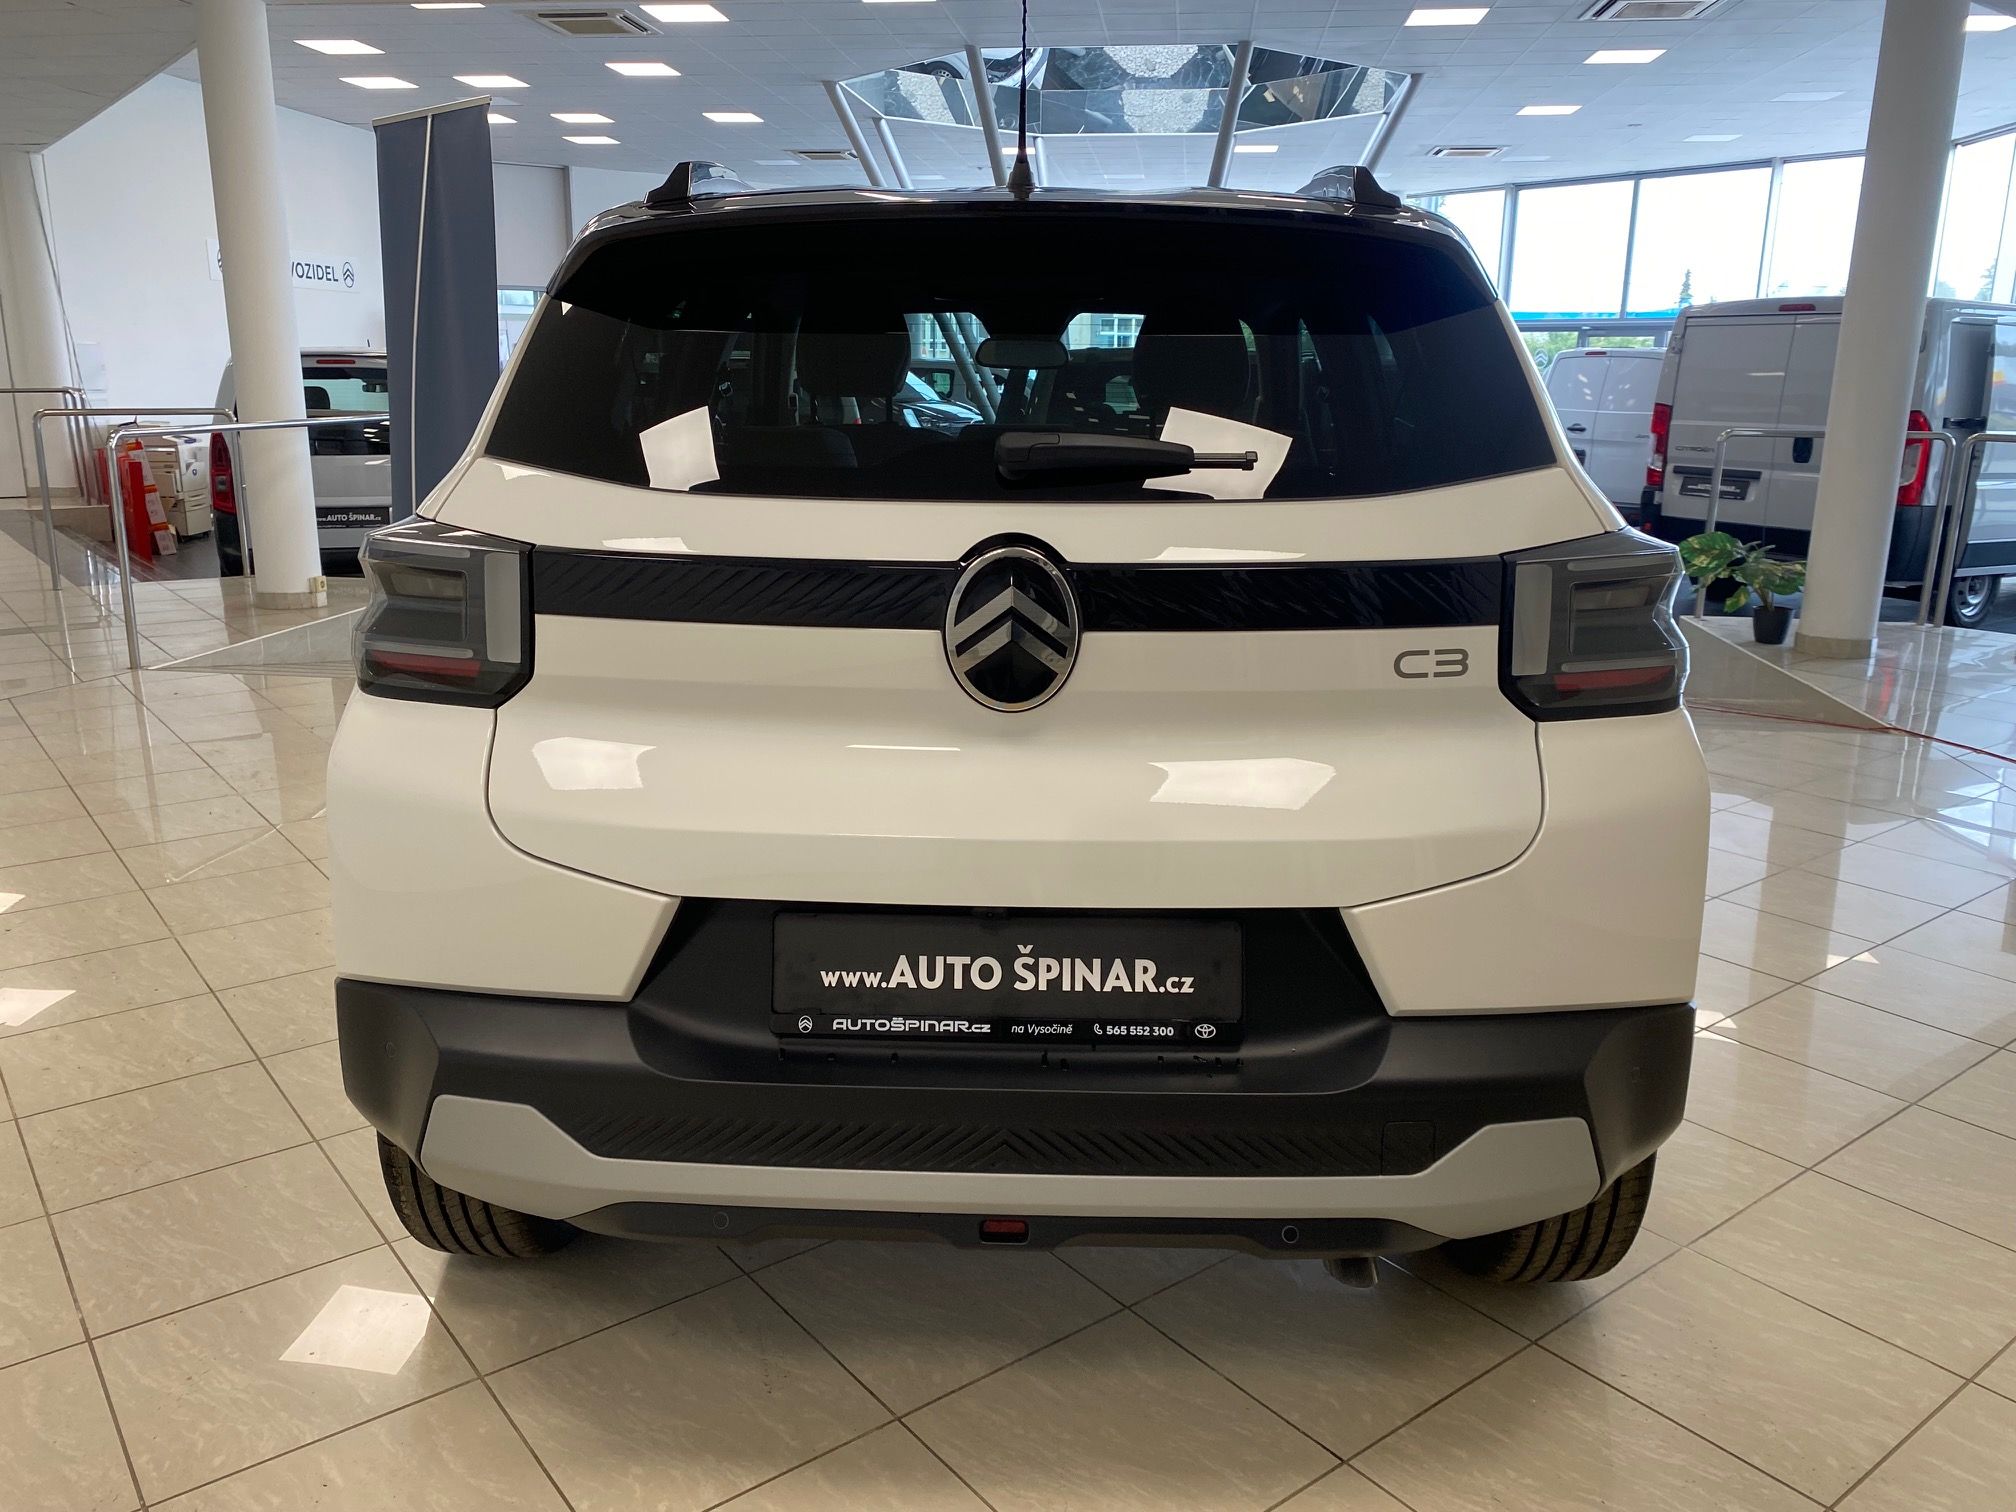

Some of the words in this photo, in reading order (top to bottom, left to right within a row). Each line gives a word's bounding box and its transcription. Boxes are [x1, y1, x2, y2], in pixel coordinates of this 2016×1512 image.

[1393, 648, 1469, 679] C3
[820, 954, 1003, 991] www.AUTO
[1013, 944, 1195, 994] ŠPINAR.cz
[1011, 1025, 1025, 1034] na
[1027, 1023, 1073, 1036] Vysočině
[1106, 1025, 1128, 1036] 565
[1129, 1025, 1151, 1036] 552
[1152, 1026, 1175, 1037] 300
